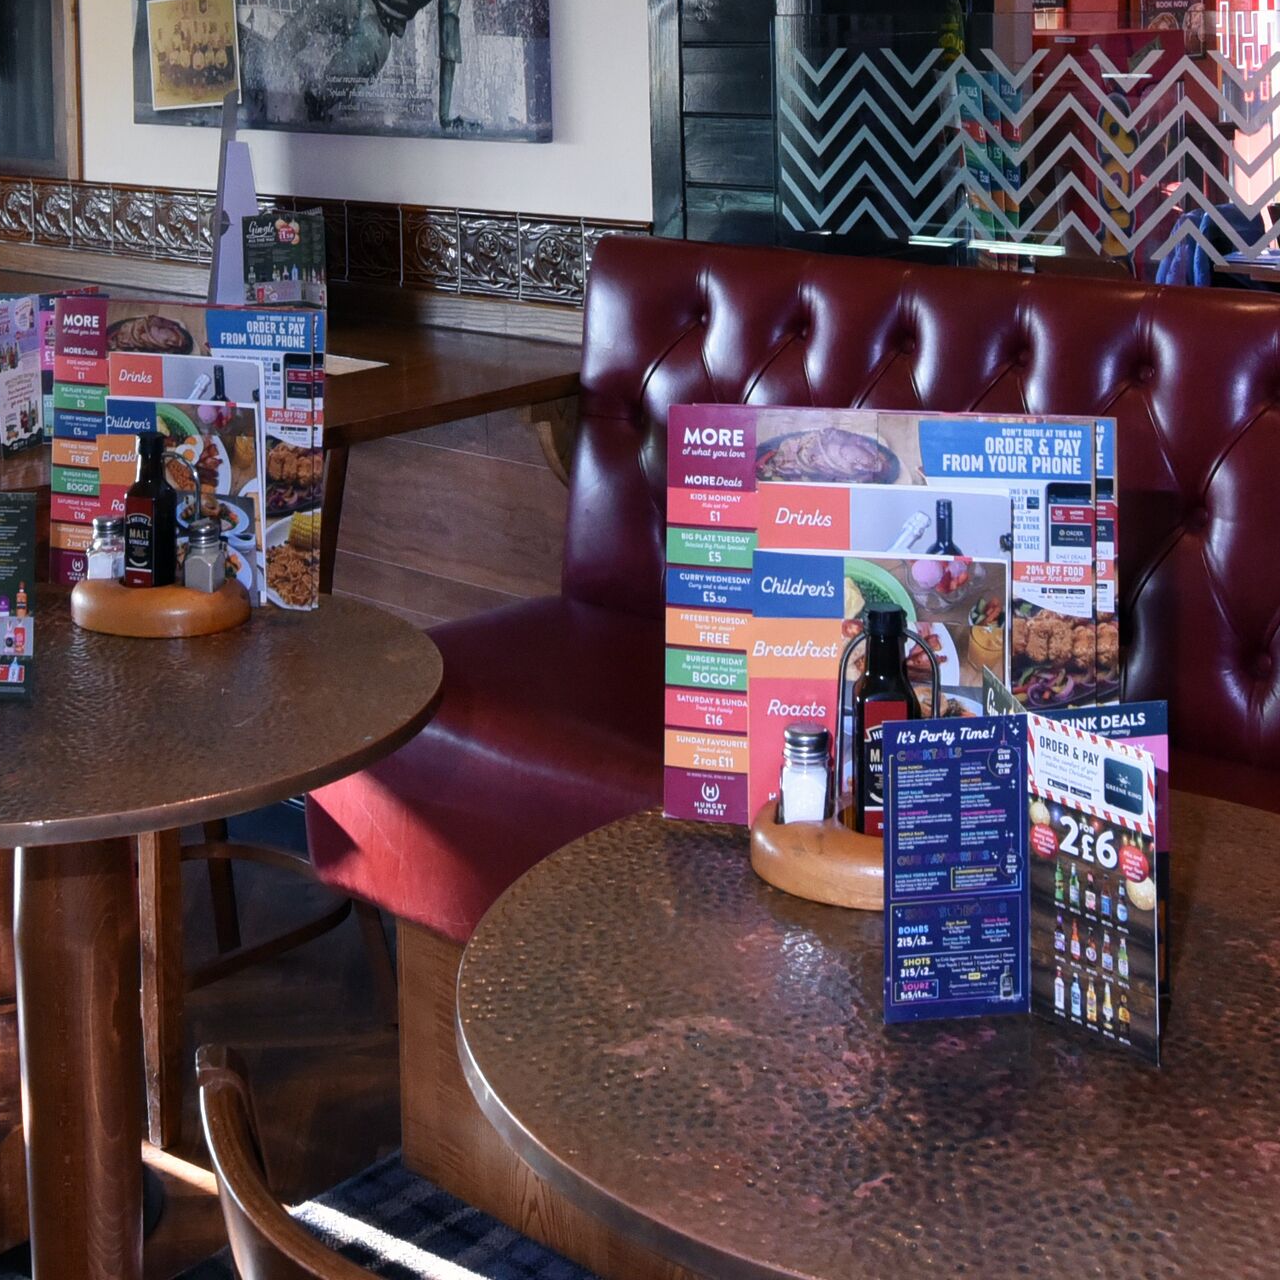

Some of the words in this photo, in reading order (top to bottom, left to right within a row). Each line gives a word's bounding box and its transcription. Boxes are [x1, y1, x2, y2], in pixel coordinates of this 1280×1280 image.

[1155, 0, 1173, 9] BOOK
[1174, 0, 1189, 8] NOW
[63, 314, 99, 328] MORE
[246, 320, 276, 334] ORDER
[279, 322, 286, 335] &
[288, 323, 305, 336] PAY
[220, 332, 246, 345] FROM
[249, 333, 273, 347] YOUR
[275, 335, 305, 348] PHONE
[119, 368, 153, 385] Drinks
[105, 414, 151, 433] Children's
[683, 427, 745, 447] MORE
[1002, 428, 1021, 437] DON'T
[1023, 428, 1044, 438] QUEUE
[1045, 429, 1054, 438] AT
[1055, 429, 1067, 438] THE
[1068, 430, 1082, 438] BAR
[682, 447, 692, 455] of
[692, 448, 711, 457] what
[712, 449, 728, 459] you
[728, 449, 746, 458] love
[985, 437, 1033, 455] ORDER
[1038, 438, 1049, 456] &
[1054, 439, 1081, 457] PAY
[71, 455, 90, 464] FREE
[101, 451, 137, 463] Break
[942, 454, 984, 472] FROM
[988, 455, 1028, 474] YOUR
[1032, 456, 1082, 475] PHONE
[66, 482, 94, 493] BOGOF
[690, 493, 707, 502] KIDS
[708, 494, 741, 503] MONDAY
[710, 510, 721, 522] £1
[775, 507, 832, 527] Drinks
[129, 528, 150, 539] MALT
[681, 533, 694, 541] BIG
[695, 534, 716, 543] PLATE
[717, 535, 750, 545] TUESDAY
[128, 539, 150, 547] VINEGAR
[709, 551, 721, 562] £5
[1026, 565, 1044, 576] 20%
[1046, 565, 1061, 576] OFF
[1063, 566, 1084, 577] FOOD
[680, 573, 704, 583] CURRY
[705, 575, 751, 585] WEDNESDAY
[761, 576, 835, 597] Children's
[703, 591, 727, 604] £5.50
[680, 613, 710, 623] FREEBIE
[699, 631, 730, 645] FREE
[752, 640, 838, 658] Breakfast
[686, 654, 716, 664] BURGER
[717, 656, 744, 665] FRIDAY
[692, 672, 737, 686] BOGOF
[676, 694, 714, 705] SATURDAY
[715, 697, 720, 705] &
[721, 697, 748, 708] SUNDA
[767, 699, 826, 717] Roasts
[705, 714, 723, 726] £16
[1061, 717, 1097, 730] RINK
[1100, 712, 1146, 728] DEALS
[676, 735, 706, 746] SUNDAY
[706, 738, 748, 749] FAVOURITE
[897, 730, 916, 744] It's
[919, 728, 955, 746] Party
[960, 726, 995, 741] Time!
[1039, 735, 1069, 757] ORDER
[1072, 747, 1079, 760] &
[1082, 749, 1100, 767] PAY
[693, 754, 700, 766] 2
[701, 758, 717, 766] FOR
[718, 756, 734, 768] £11
[1105, 783, 1126, 795] GREENE
[1127, 790, 1142, 800] KING
[694, 801, 727, 810] HUNGRY
[697, 807, 724, 816] HORSE
[1059, 815, 1079, 856] 2
[1079, 822, 1095, 835] FOR
[898, 924, 929, 935] BOMBS
[903, 957, 931, 967] SHOTS
